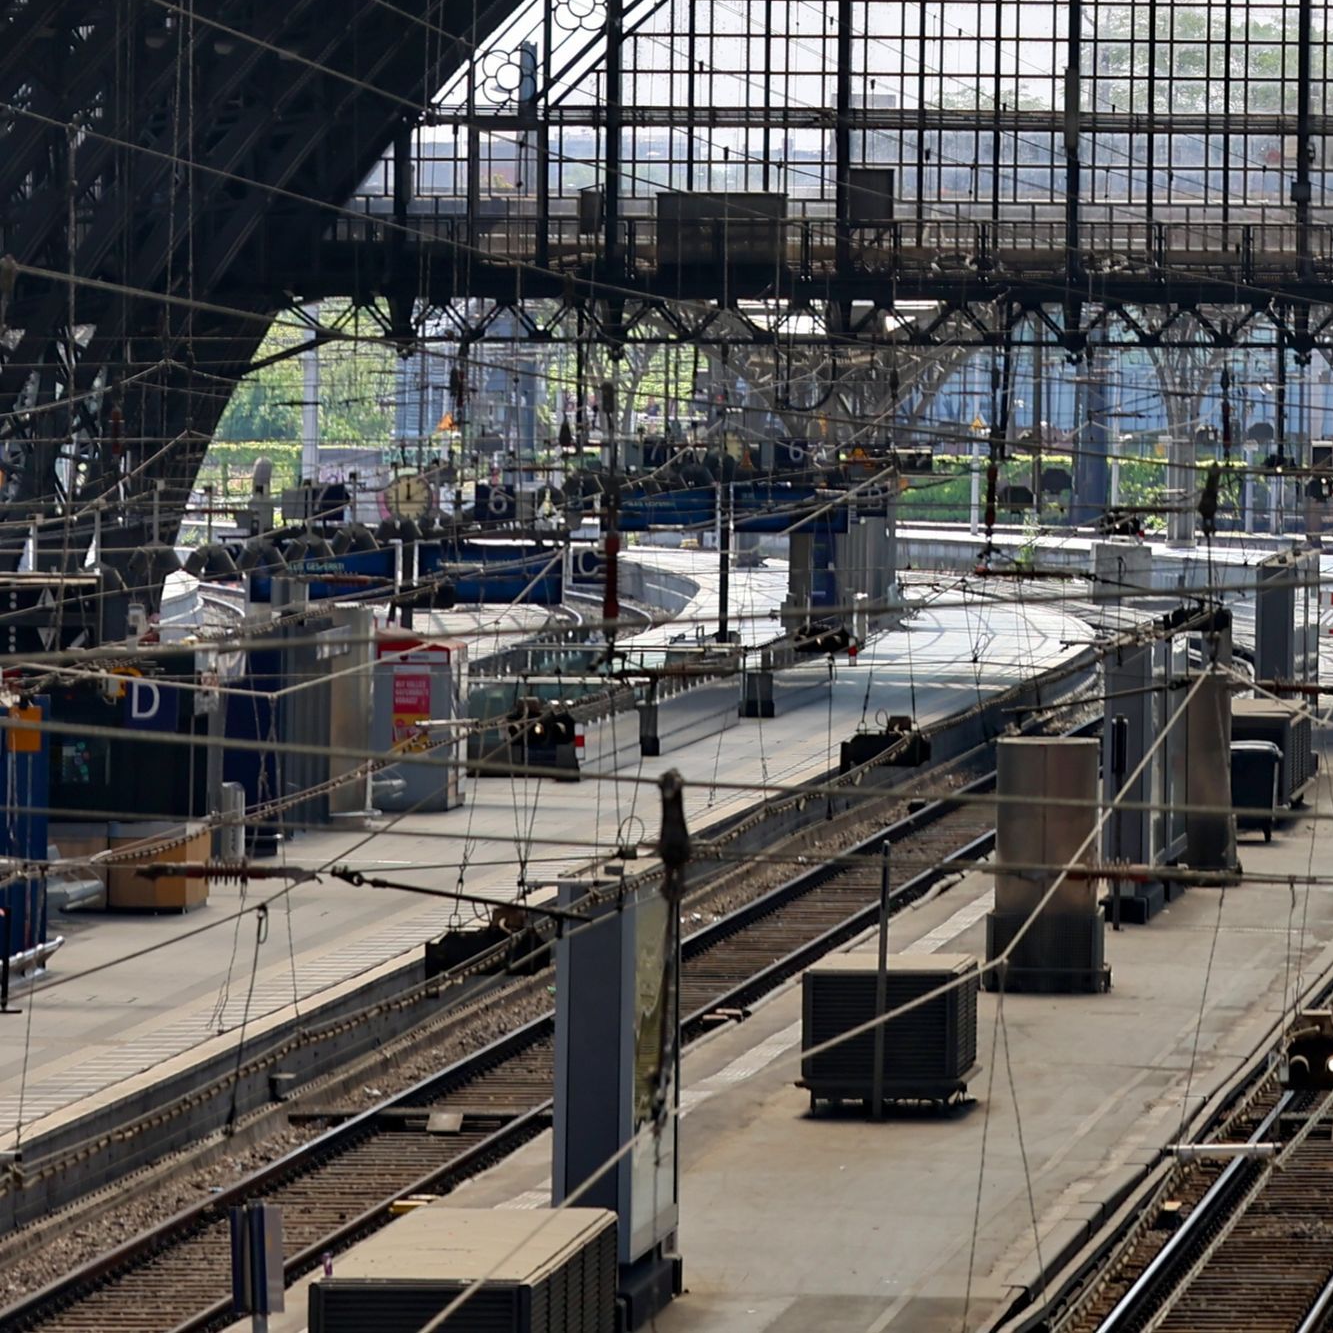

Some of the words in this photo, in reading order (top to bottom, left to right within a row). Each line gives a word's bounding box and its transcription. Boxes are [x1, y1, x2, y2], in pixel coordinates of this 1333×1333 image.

[489, 486, 508, 514] 6
[578, 547, 599, 576] C
[132, 680, 161, 719] D
